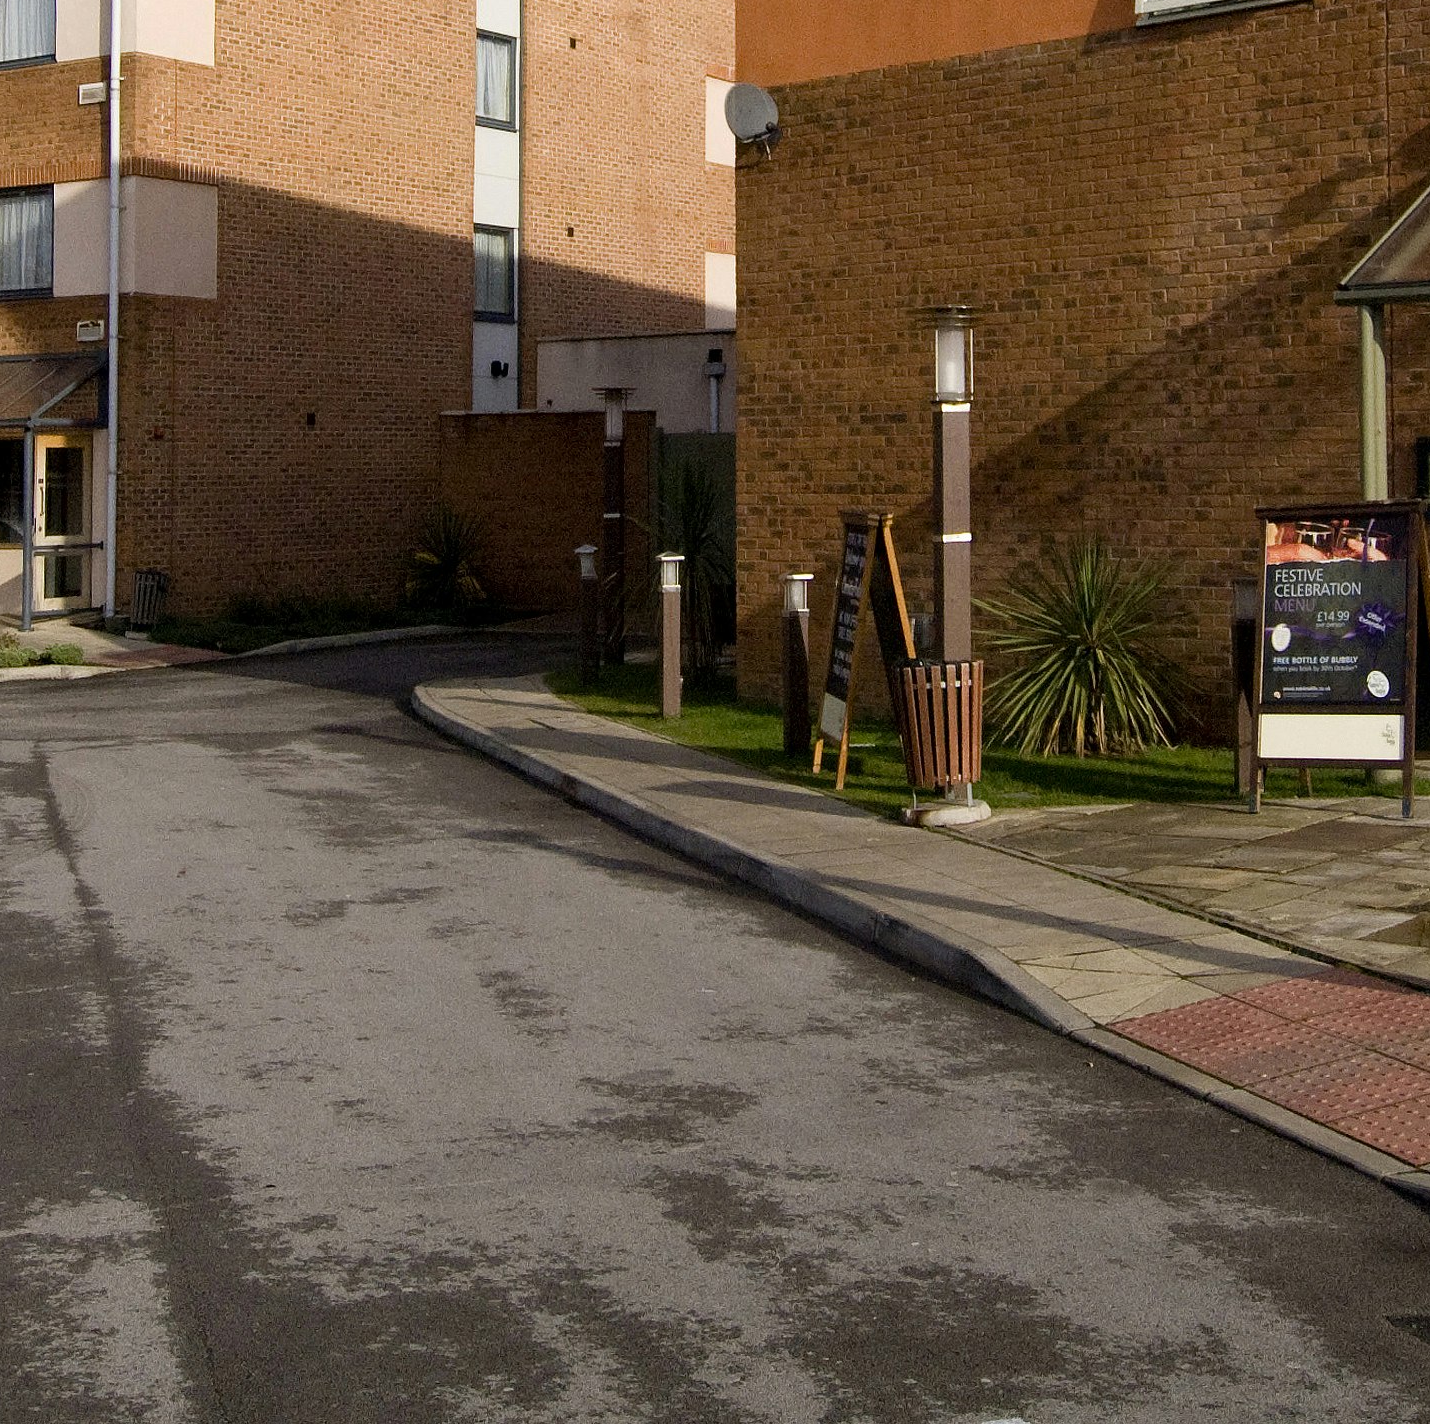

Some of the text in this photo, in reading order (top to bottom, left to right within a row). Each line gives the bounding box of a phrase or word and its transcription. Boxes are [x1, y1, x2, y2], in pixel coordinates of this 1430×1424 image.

[1275, 568, 1324, 583] FESTIVE
[1274, 582, 1362, 598] CELEBRATION
[1274, 598, 1316, 613] MENU
[1273, 656, 1359, 665] FREE BOTTLE OF BUBBLY
